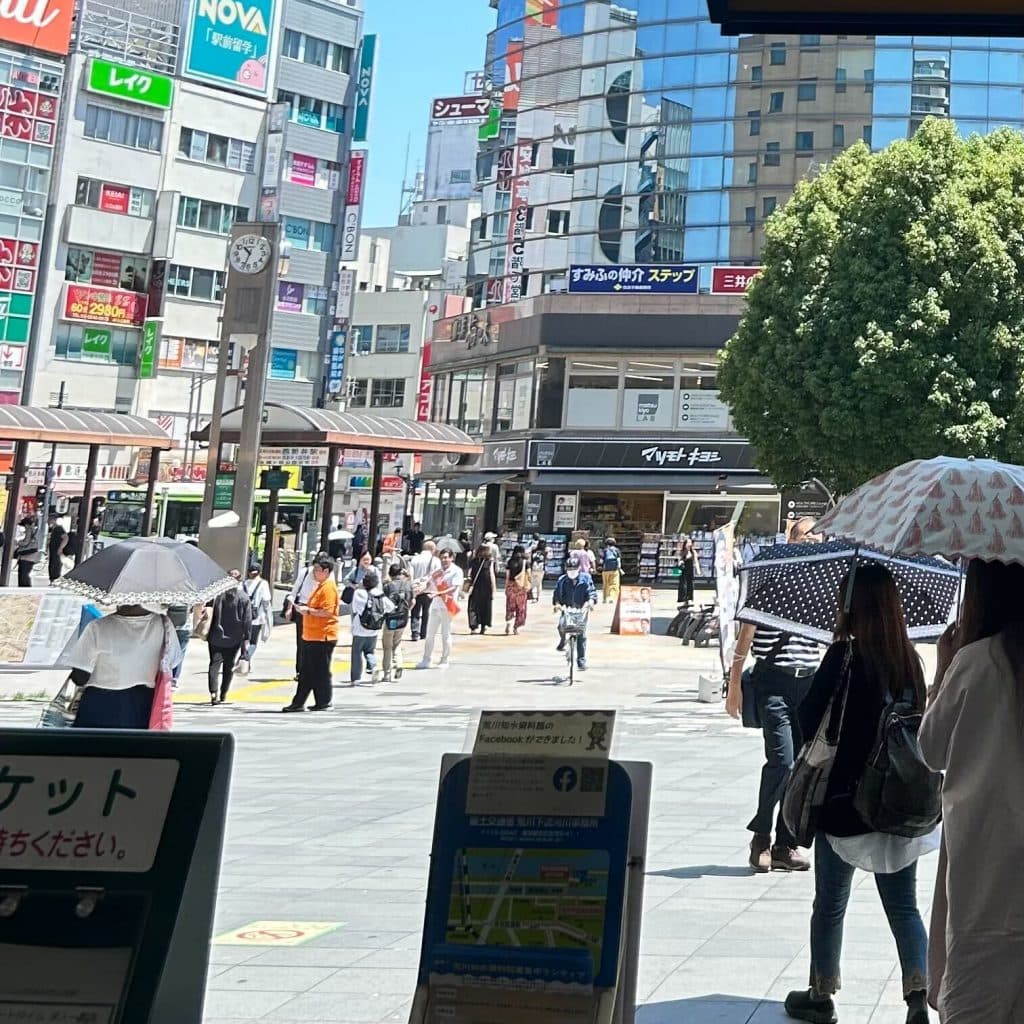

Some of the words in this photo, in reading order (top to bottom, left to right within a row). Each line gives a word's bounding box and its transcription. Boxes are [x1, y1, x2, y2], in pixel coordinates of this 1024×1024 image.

[109, 67, 152, 94] レイク
[358, 66, 371, 106] NOVA
[571, 268, 645, 283] すみふの仲介
[648, 268, 695, 282] ステップ
[84, 332, 108, 345] レイク
[0, 829, 126, 861] ちください。
